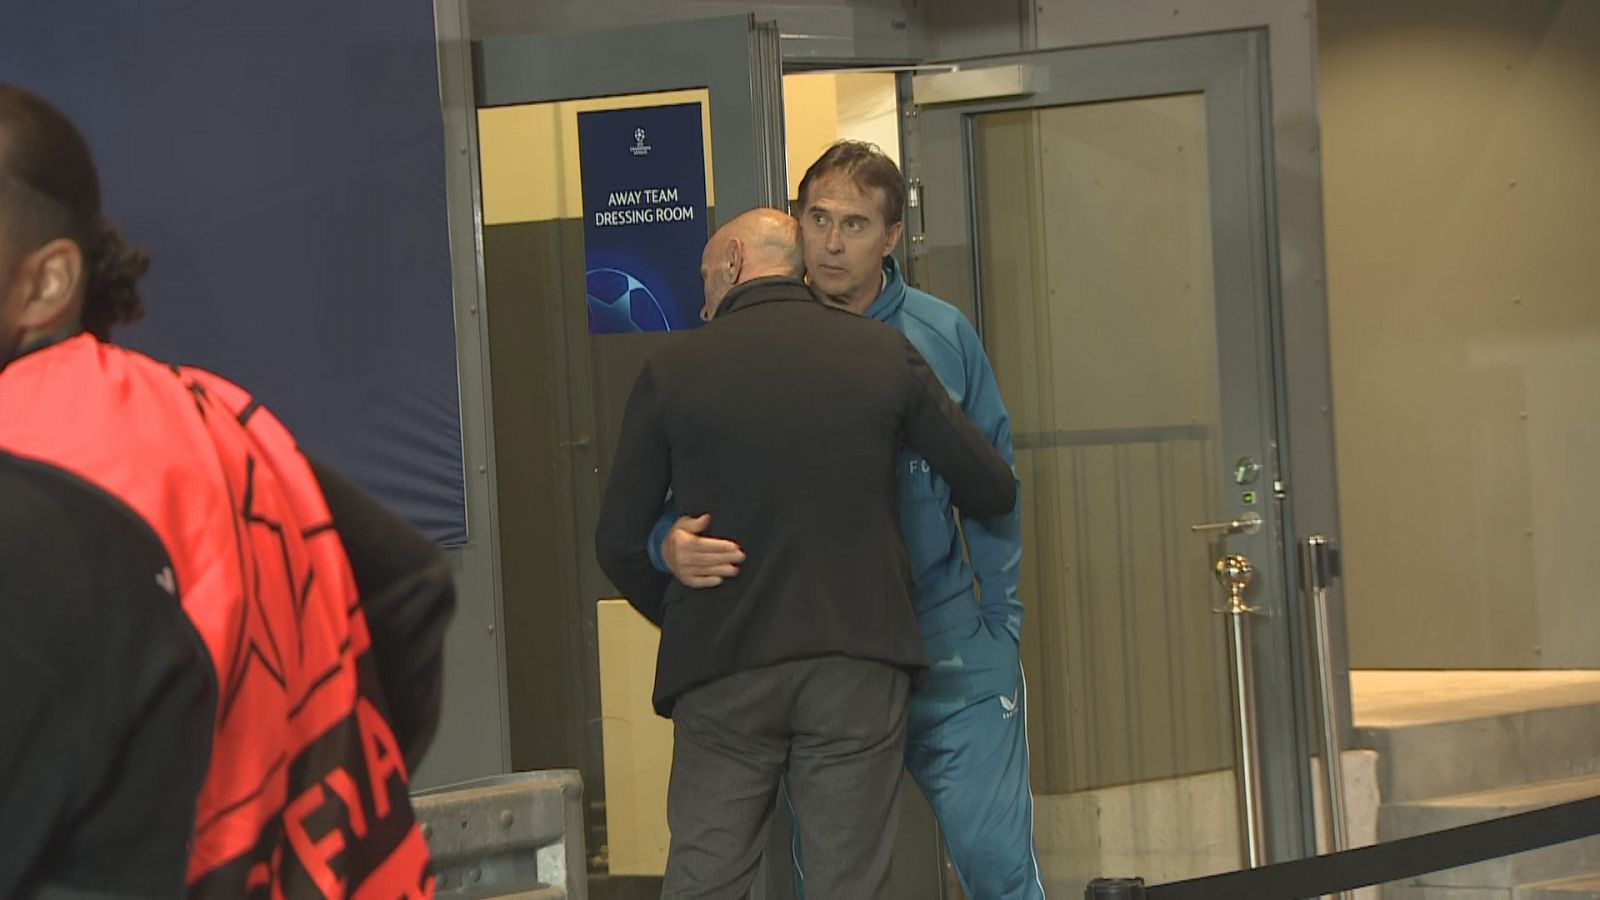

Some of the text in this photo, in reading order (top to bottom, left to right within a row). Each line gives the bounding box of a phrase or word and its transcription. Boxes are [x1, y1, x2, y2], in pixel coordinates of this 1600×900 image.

[608, 187, 678, 207] AWAY TEAM
[595, 206, 694, 226] DRESSING ROOM
